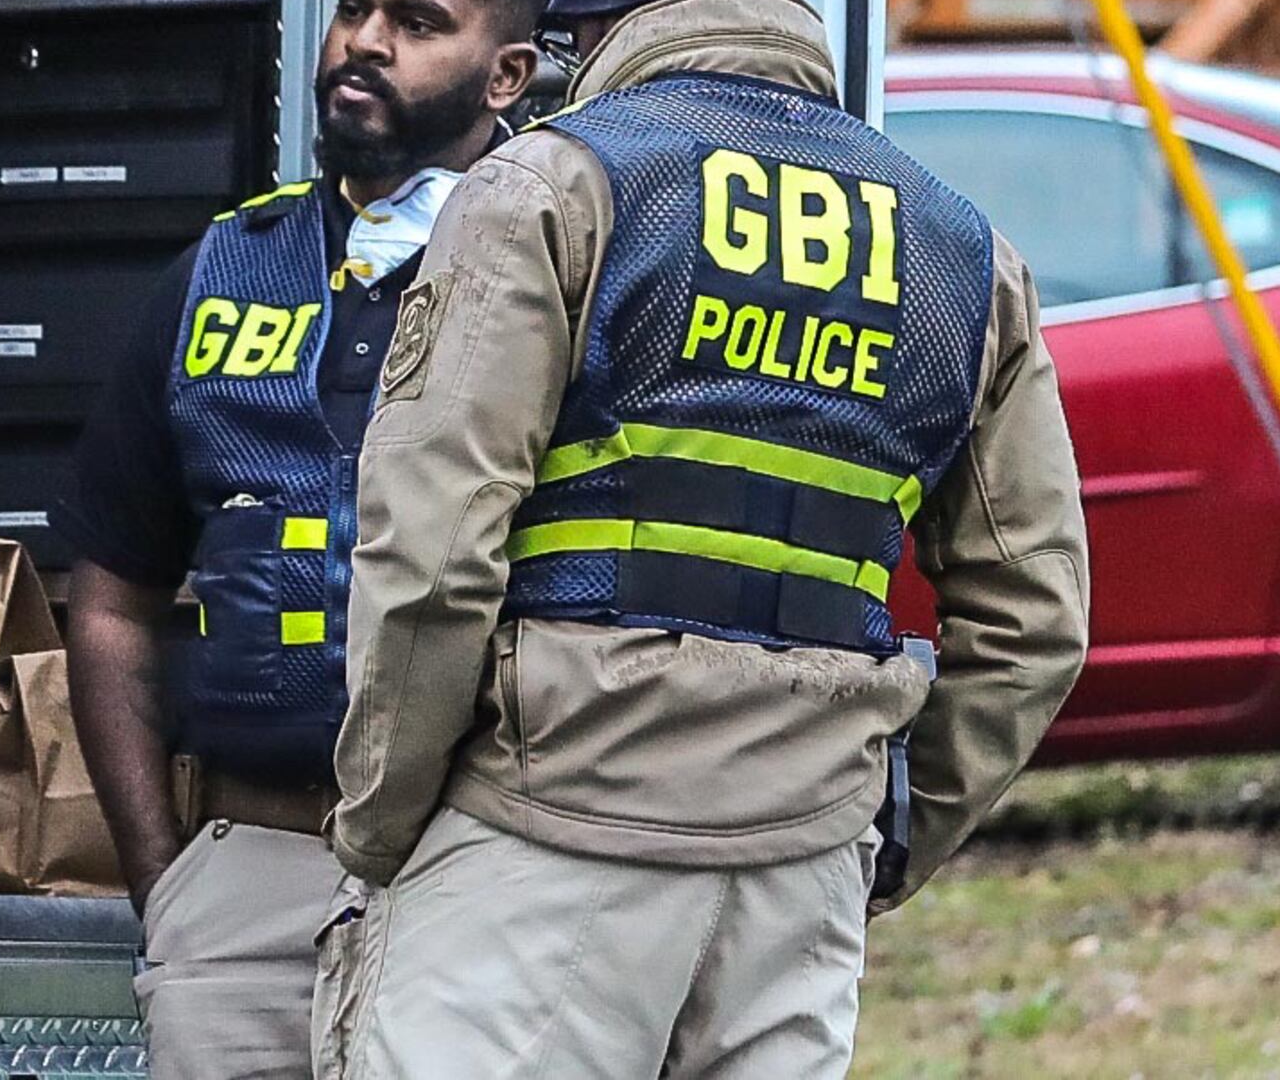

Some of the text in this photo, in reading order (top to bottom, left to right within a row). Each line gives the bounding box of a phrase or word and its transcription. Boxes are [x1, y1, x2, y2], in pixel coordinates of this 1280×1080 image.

[701, 148, 900, 306] GBI
[184, 296, 323, 380] GBI
[681, 294, 896, 400] POLICE
